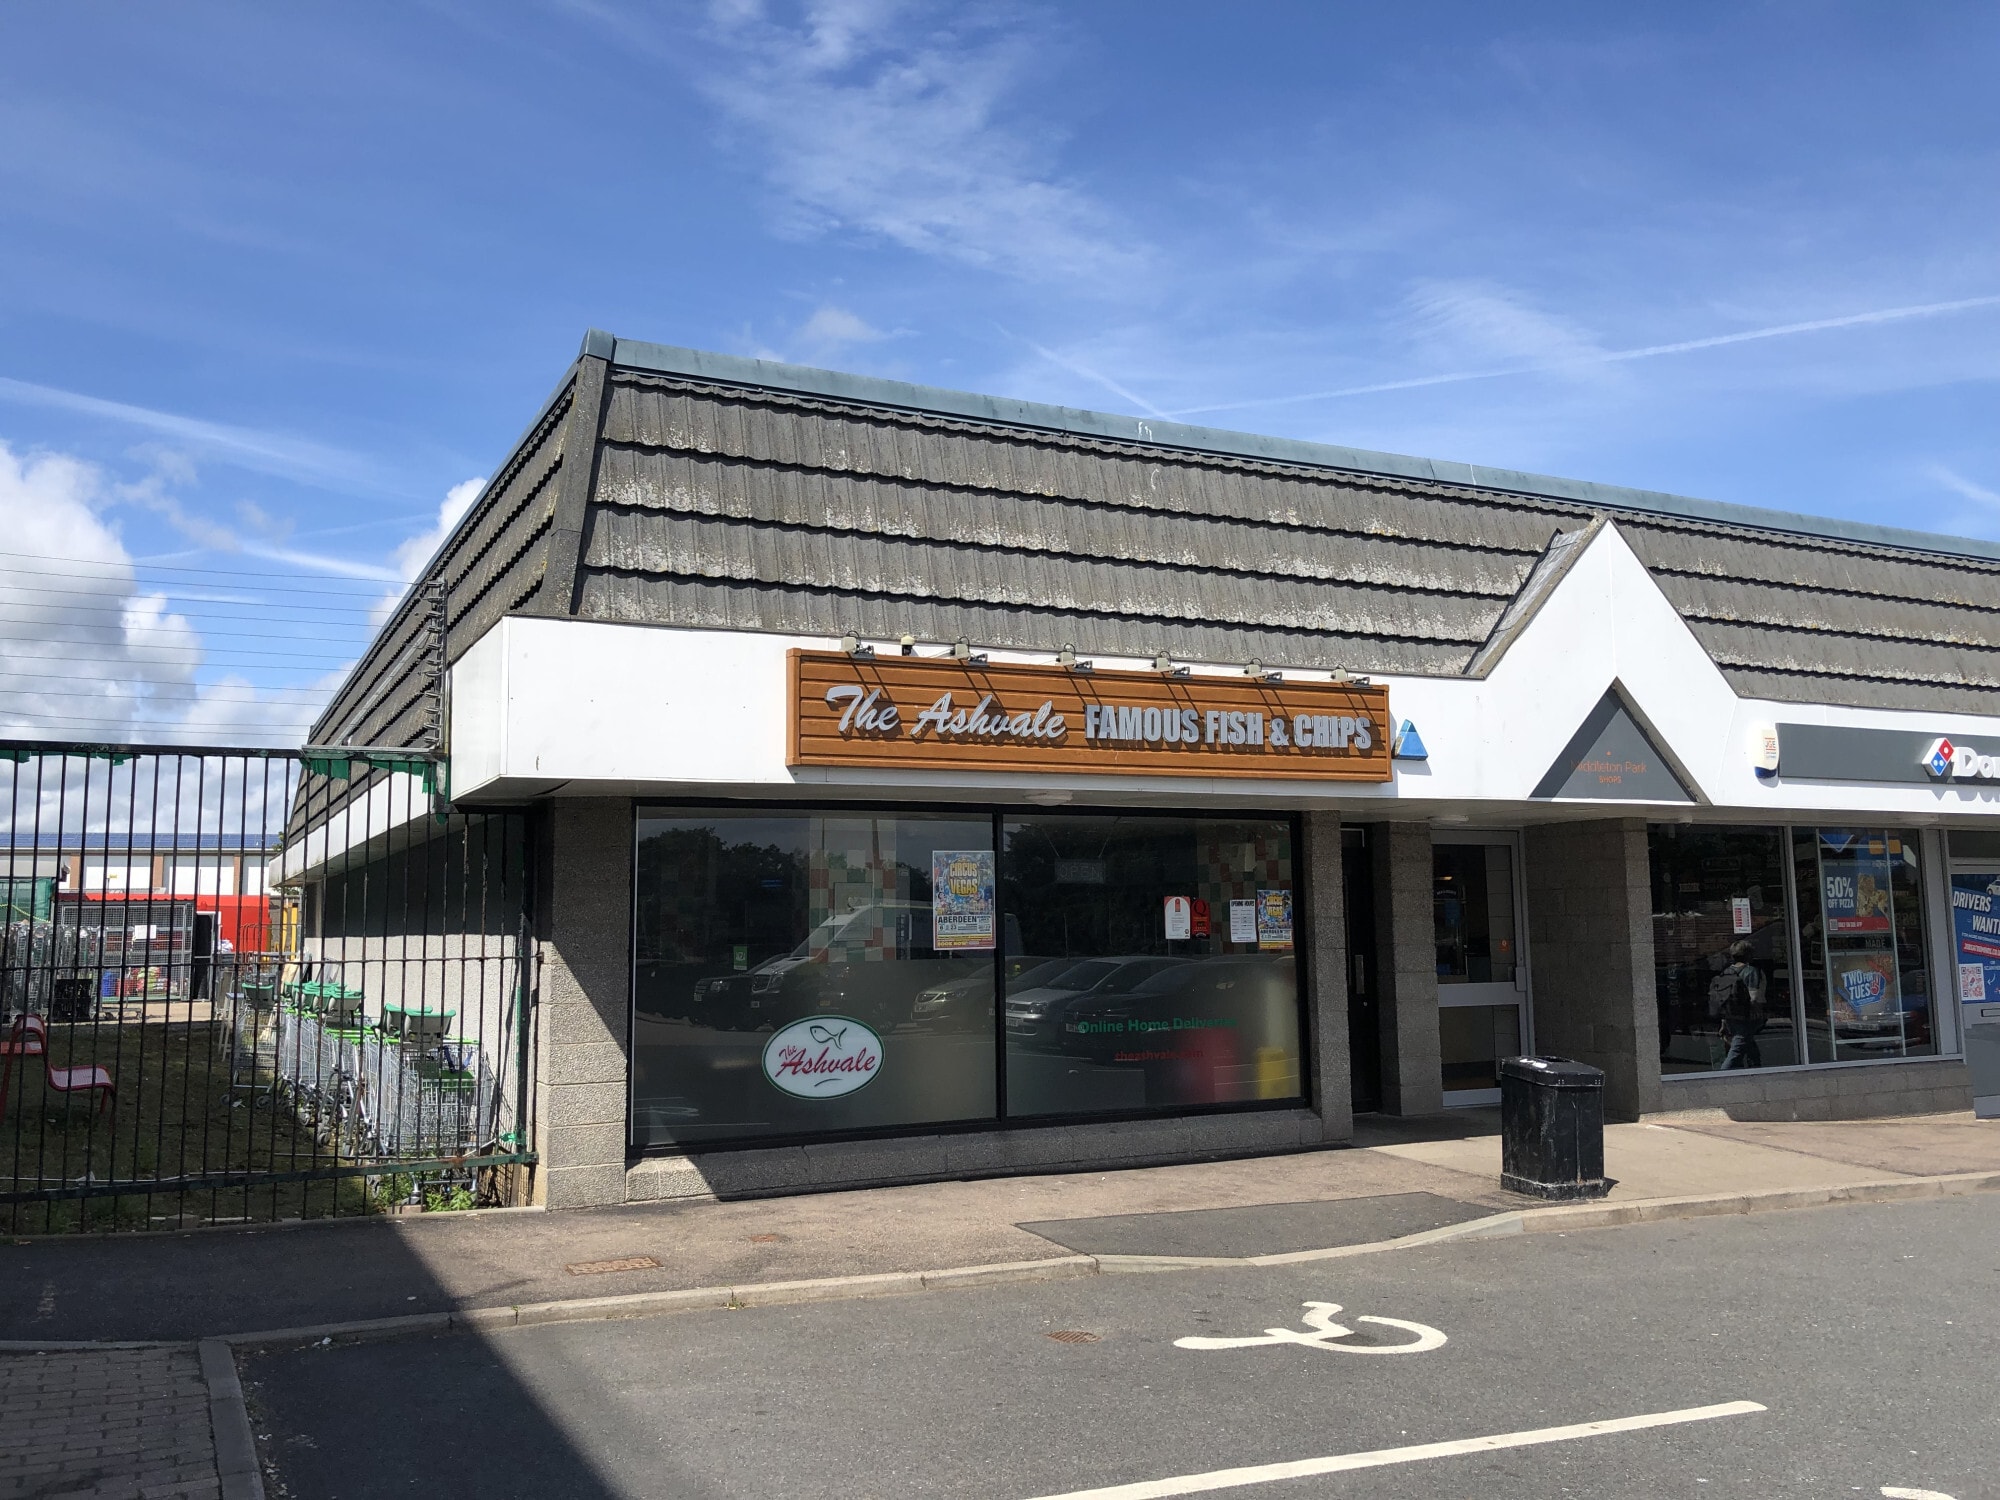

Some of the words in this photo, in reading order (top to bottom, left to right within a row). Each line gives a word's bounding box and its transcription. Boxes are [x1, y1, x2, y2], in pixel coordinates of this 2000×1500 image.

[824, 685, 899, 732] The
[909, 692, 1066, 738] Ashvale
[1084, 704, 1200, 744] FAMOUS
[1205, 710, 1264, 746] FISH
[1269, 717, 1290, 747] &
[1293, 714, 1372, 749] CHIPS
[1571, 760, 1623, 773] Middleton
[1625, 761, 1647, 774] Park
[1951, 746, 2000, 778] Do
[1598, 775, 1622, 784] SHOPS
[949, 862, 978, 877] CIRCUS
[950, 878, 978, 895] VEGAS
[1826, 876, 1854, 898] 50%
[1827, 899, 1838, 908] OFF
[1839, 899, 1854, 908] PIZZA
[1953, 890, 1992, 913] DRIVERS
[938, 915, 977, 924] ABERDEEN
[1972, 914, 2000, 935] WANT
[1841, 969, 1863, 987] TWO
[1849, 984, 1871, 1000] TUES
[1079, 1021, 1124, 1033] Online
[1128, 1019, 1169, 1031] Home
[779, 1044, 797, 1060] The
[775, 1047, 876, 1077] Ashvale
